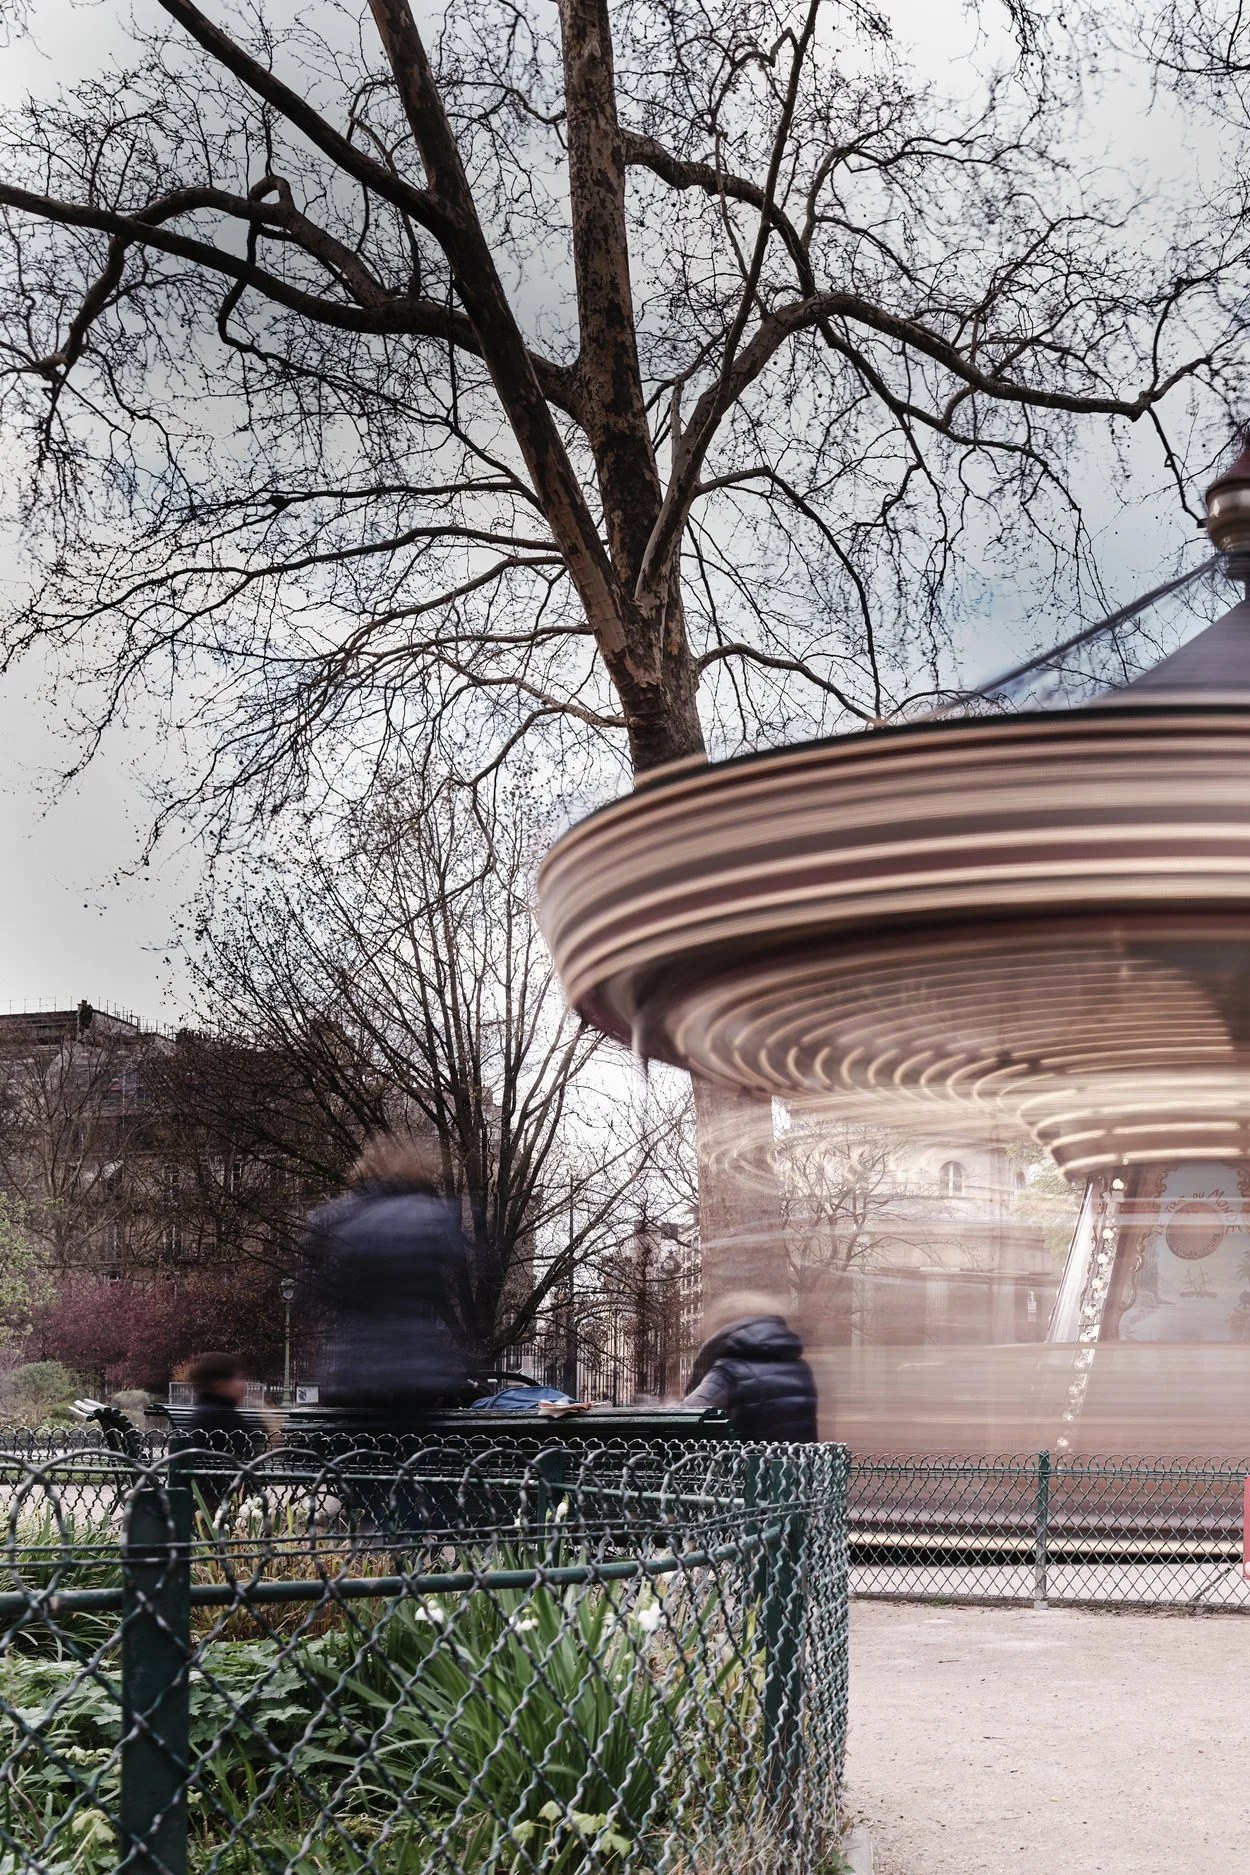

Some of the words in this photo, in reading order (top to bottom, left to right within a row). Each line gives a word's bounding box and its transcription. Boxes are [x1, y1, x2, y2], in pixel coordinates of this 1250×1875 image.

[1165, 1195, 1186, 1214] TOUR
[1192, 1191, 1206, 1200] DU
[1207, 1188, 1243, 1236] MONDE
